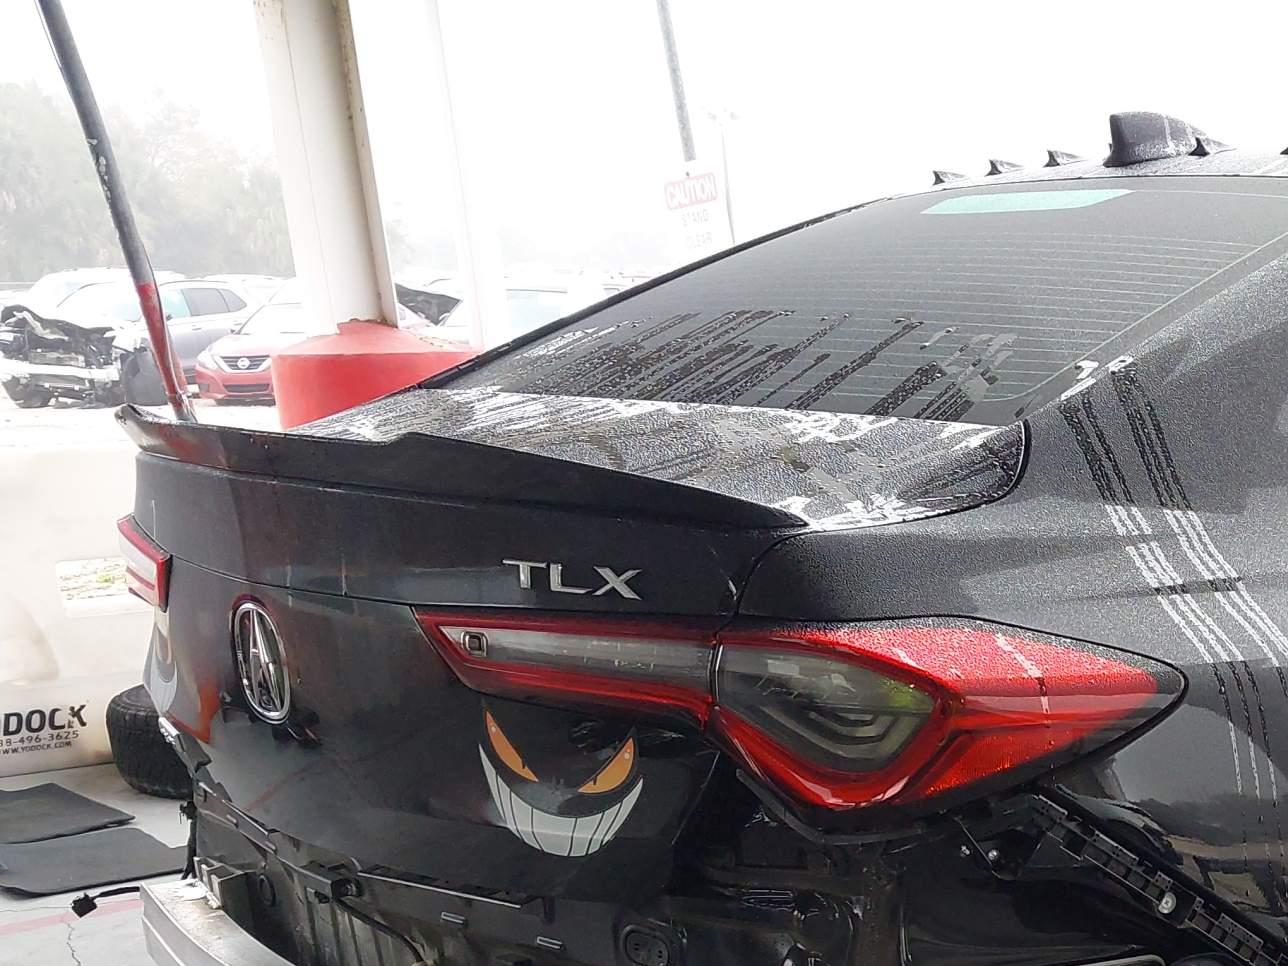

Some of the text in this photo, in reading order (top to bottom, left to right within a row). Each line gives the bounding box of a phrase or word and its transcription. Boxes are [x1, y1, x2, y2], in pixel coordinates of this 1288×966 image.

[667, 175, 717, 208] CAUTION
[502, 558, 643, 600] TLX
[0, 704, 87, 736] DOCK
